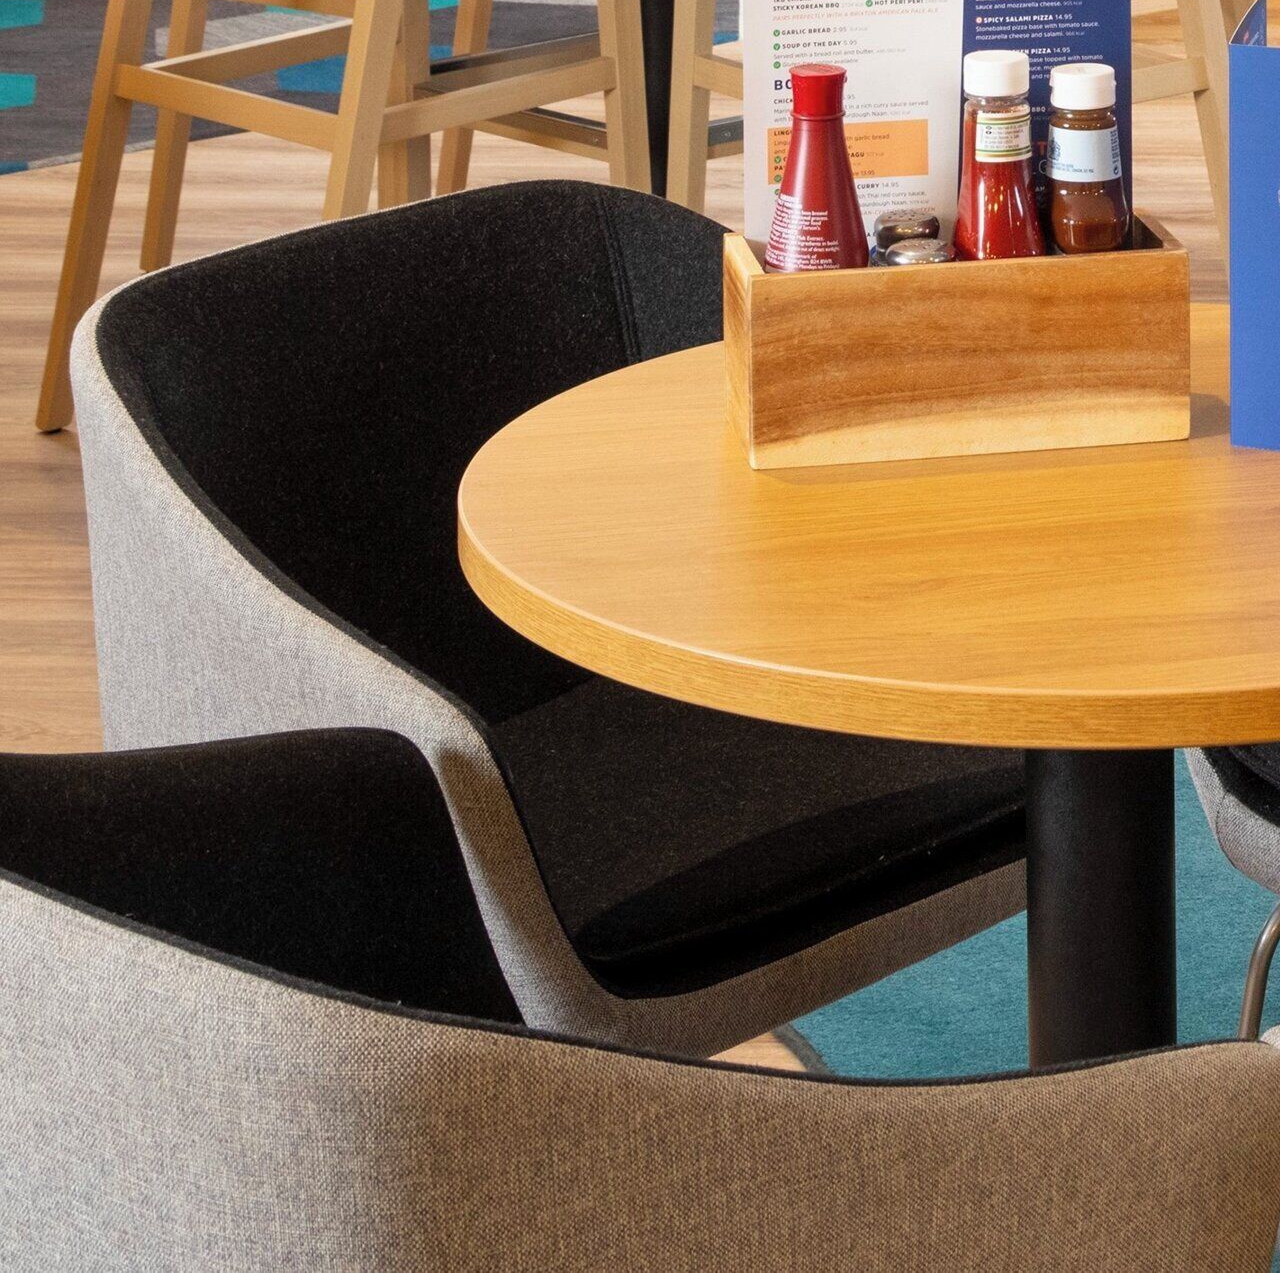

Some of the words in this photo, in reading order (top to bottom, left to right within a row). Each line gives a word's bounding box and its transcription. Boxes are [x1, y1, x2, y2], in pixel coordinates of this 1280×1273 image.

[1006, 1, 1039, 9] mozzarella
[983, 16, 1004, 24] SPICY
[781, 28, 807, 36] GARLIC
[975, 25, 1011, 33] Stonebaked
[975, 33, 1008, 41] mozzarella
[1031, 47, 1052, 55] PIZZA
[1044, 56, 1067, 64] topped
